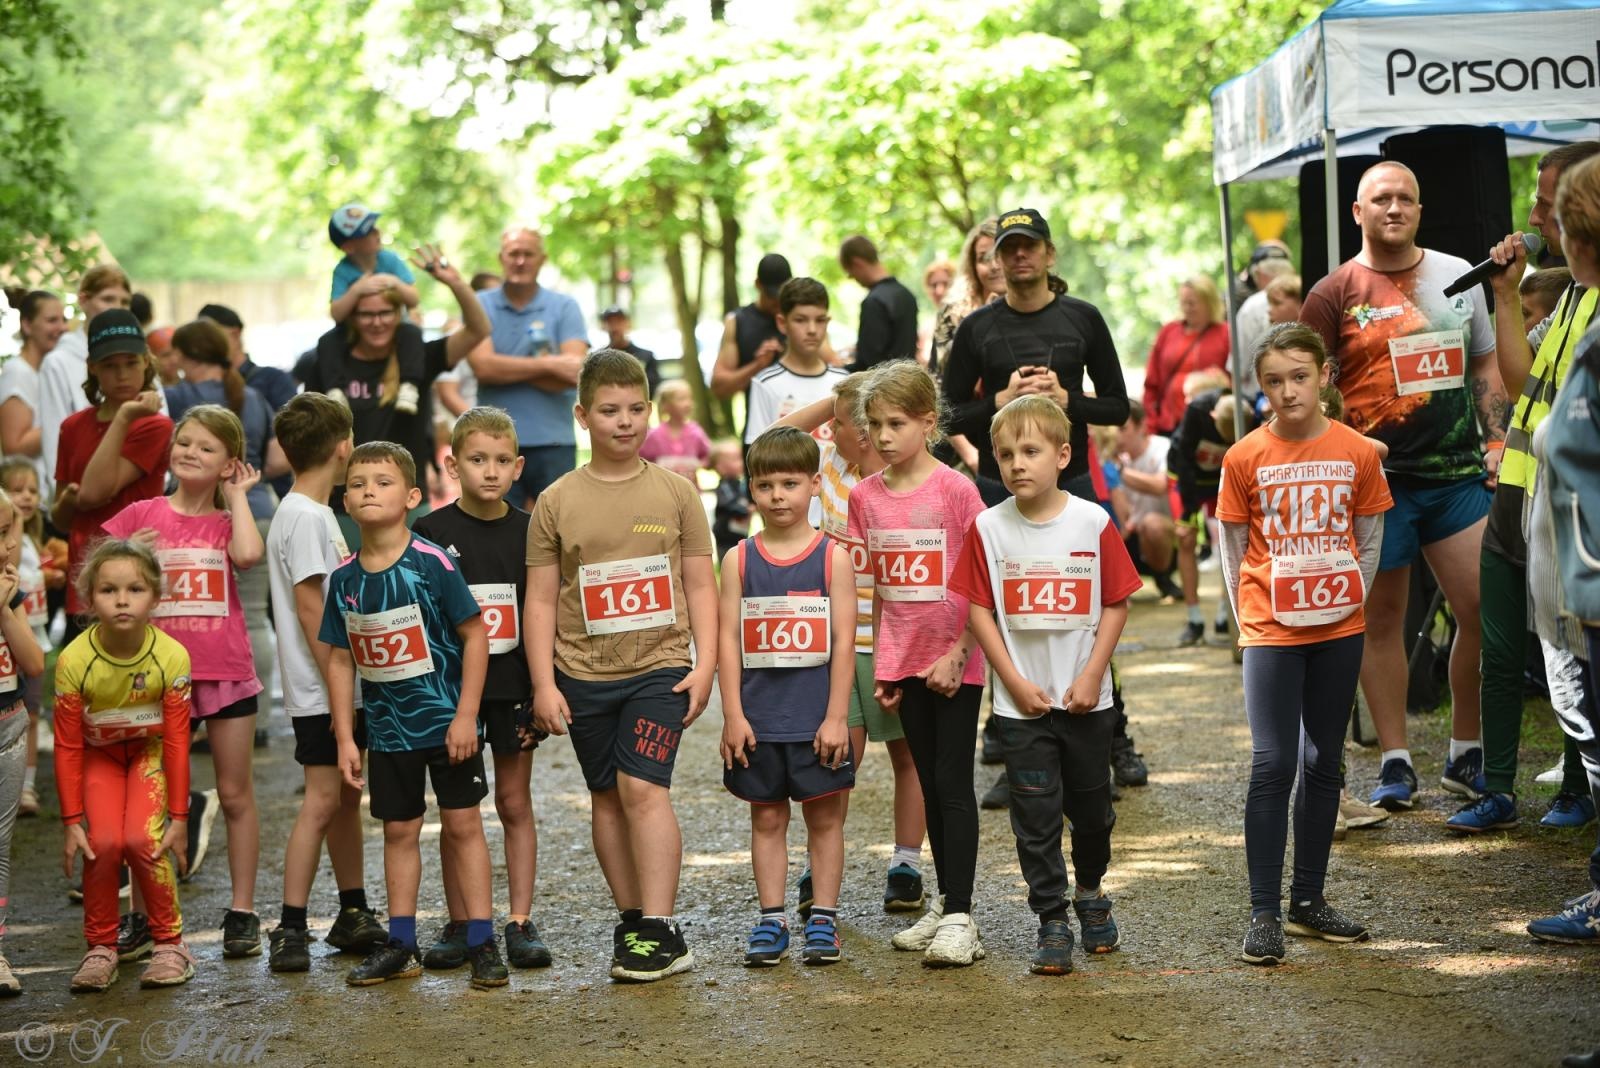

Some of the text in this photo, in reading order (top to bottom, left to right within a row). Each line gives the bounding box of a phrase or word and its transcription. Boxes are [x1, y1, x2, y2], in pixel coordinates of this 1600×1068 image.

[1416, 351, 1450, 377] 44
[1260, 464, 1353, 482] CHARYTATYWNE
[1258, 484, 1353, 536] KIDS
[585, 568, 601, 577] Bieg
[644, 564, 660, 573] 4500
[878, 553, 929, 583] 146
[1005, 562, 1020, 570] Bieg
[1065, 566, 1083, 574] 4500
[1335, 559, 1349, 567] 4500
[160, 571, 213, 600] 141
[599, 580, 660, 616] 161
[1016, 581, 1077, 612] 145
[1290, 575, 1351, 609] 162
[391, 616, 409, 626] 4500
[746, 602, 760, 610] Bieg
[799, 605, 817, 613] 4500
[755, 620, 813, 650] 160
[358, 633, 413, 666] 152
[635, 737, 670, 762] NEW
